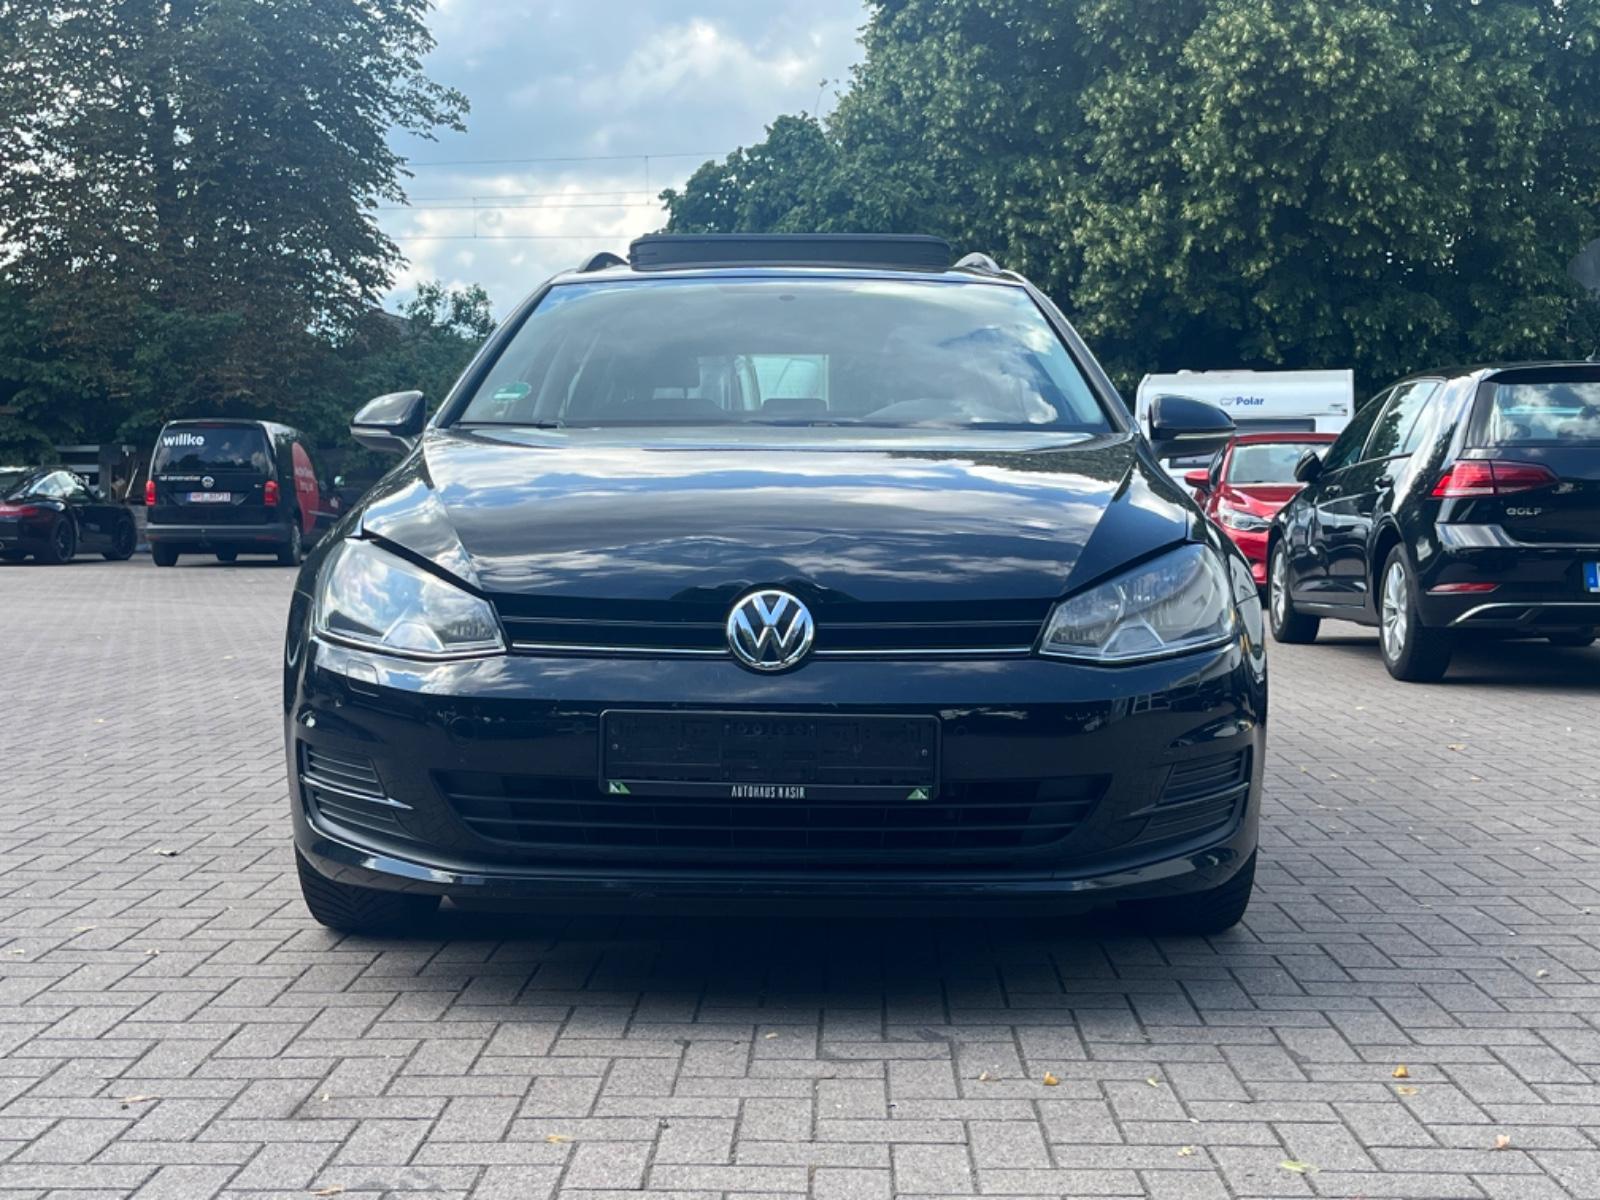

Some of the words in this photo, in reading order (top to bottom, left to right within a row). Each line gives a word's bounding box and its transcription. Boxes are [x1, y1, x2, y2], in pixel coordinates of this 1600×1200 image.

[1235, 396, 1264, 406] Polar
[163, 433, 205, 446] willke
[1506, 507, 1542, 516] GOLF
[731, 785, 776, 798] AUTOHAUS
